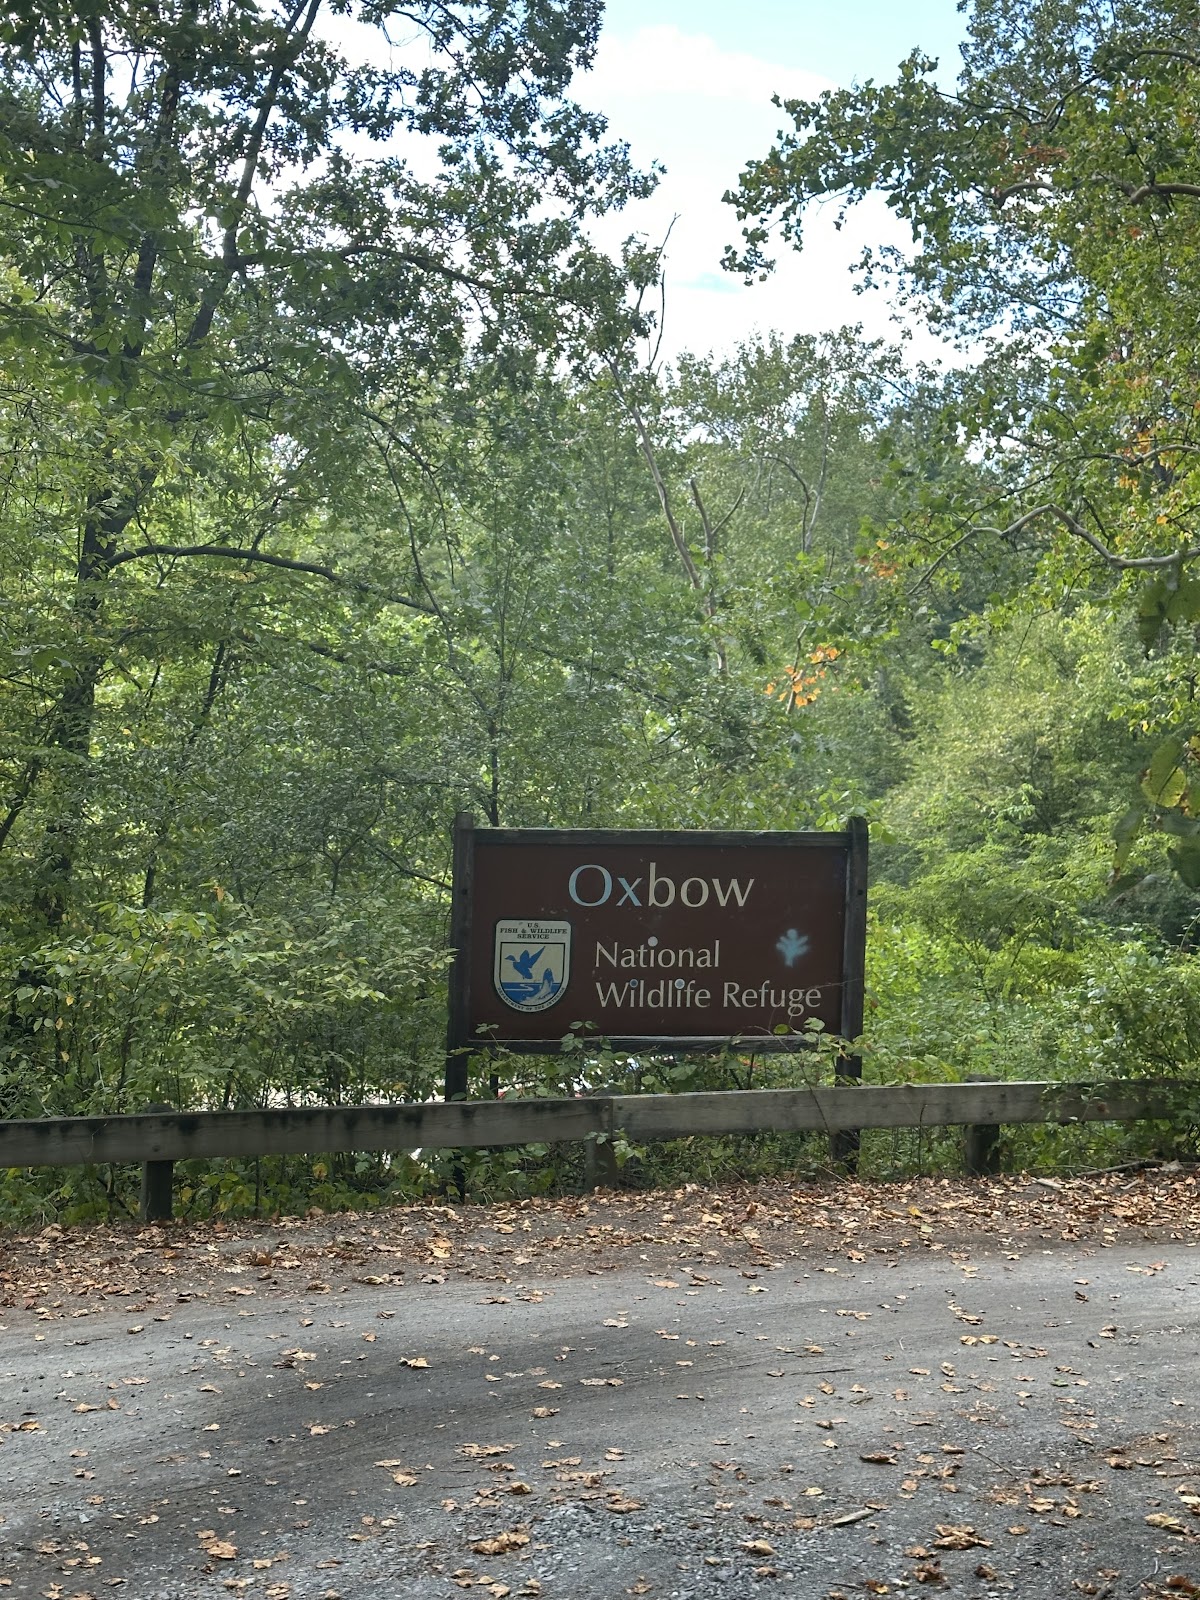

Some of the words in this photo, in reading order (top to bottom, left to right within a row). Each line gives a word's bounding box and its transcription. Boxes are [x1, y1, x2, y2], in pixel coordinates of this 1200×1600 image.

[568, 862, 755, 907] Oxbow
[595, 937, 720, 968] National
[594, 979, 711, 1008] Wildlife
[722, 980, 822, 1016] Refuge
